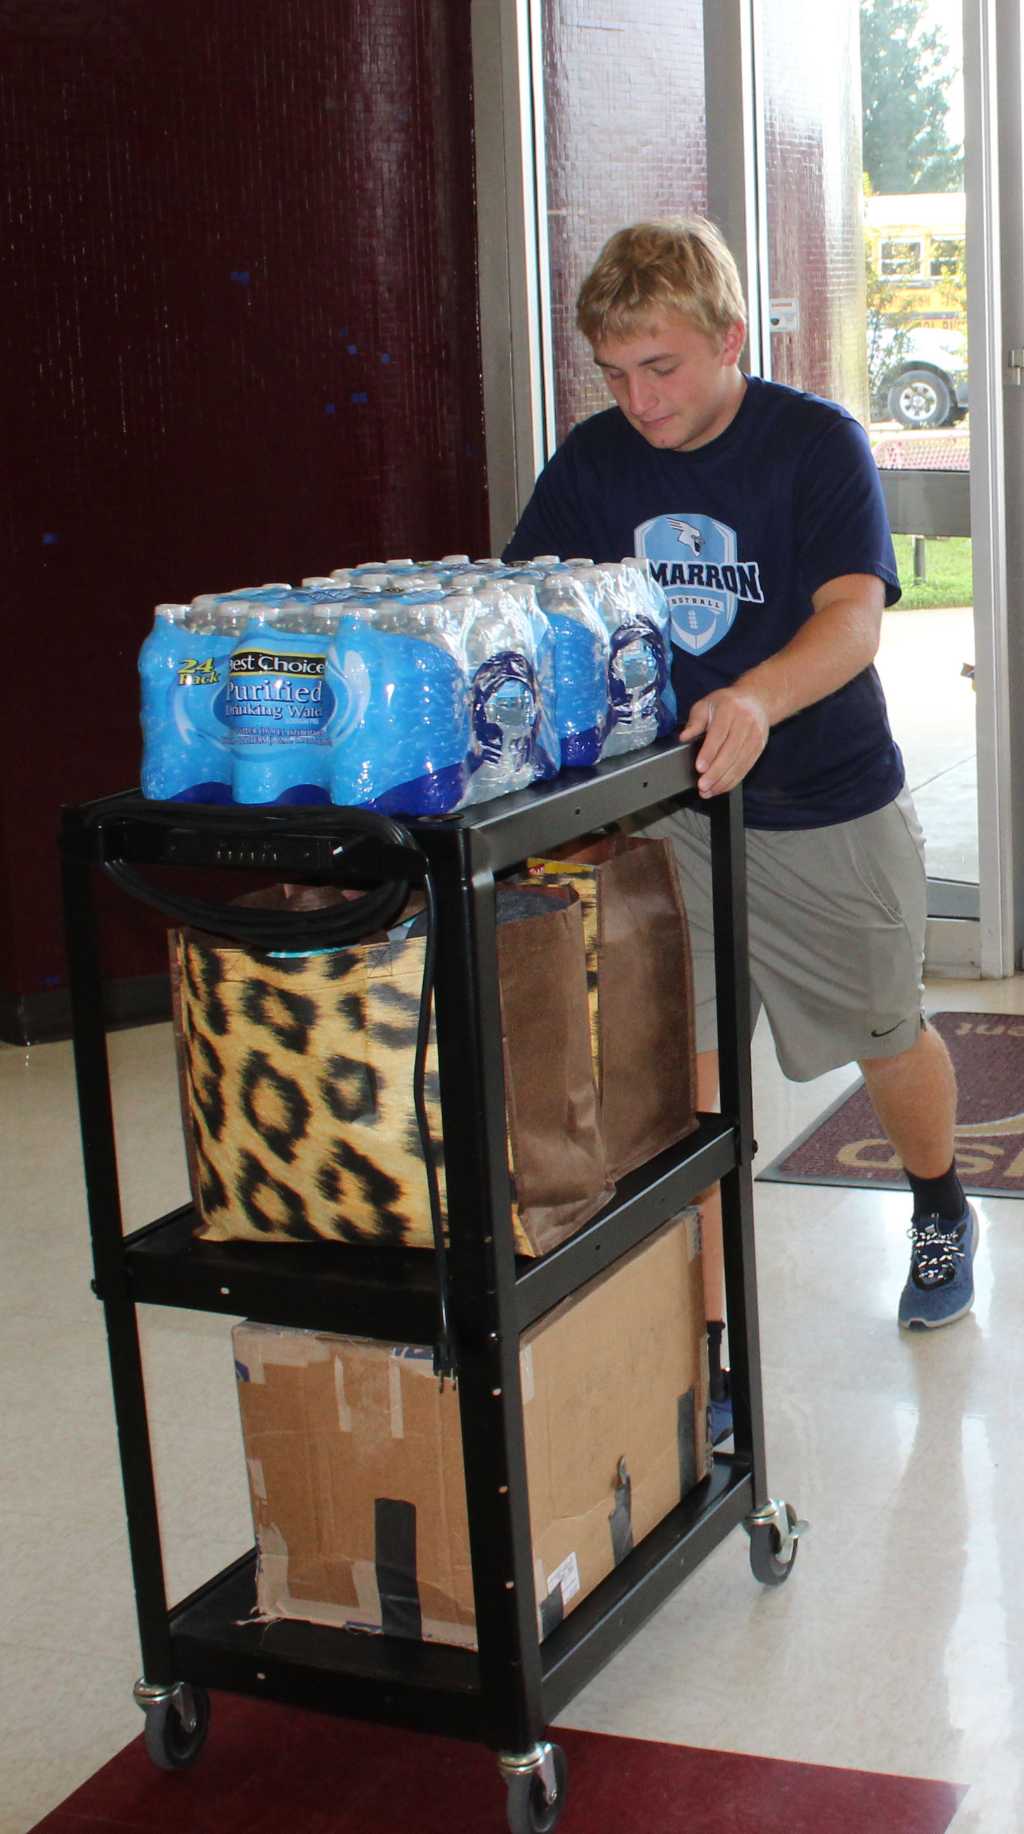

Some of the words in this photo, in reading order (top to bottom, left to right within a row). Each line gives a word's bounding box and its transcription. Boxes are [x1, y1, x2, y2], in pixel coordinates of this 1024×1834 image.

[649, 561, 764, 603] MARRON
[177, 657, 215, 673] 24
[257, 655, 325, 674] Choice
[178, 671, 221, 686] Pack
[226, 680, 323, 703] Purified
